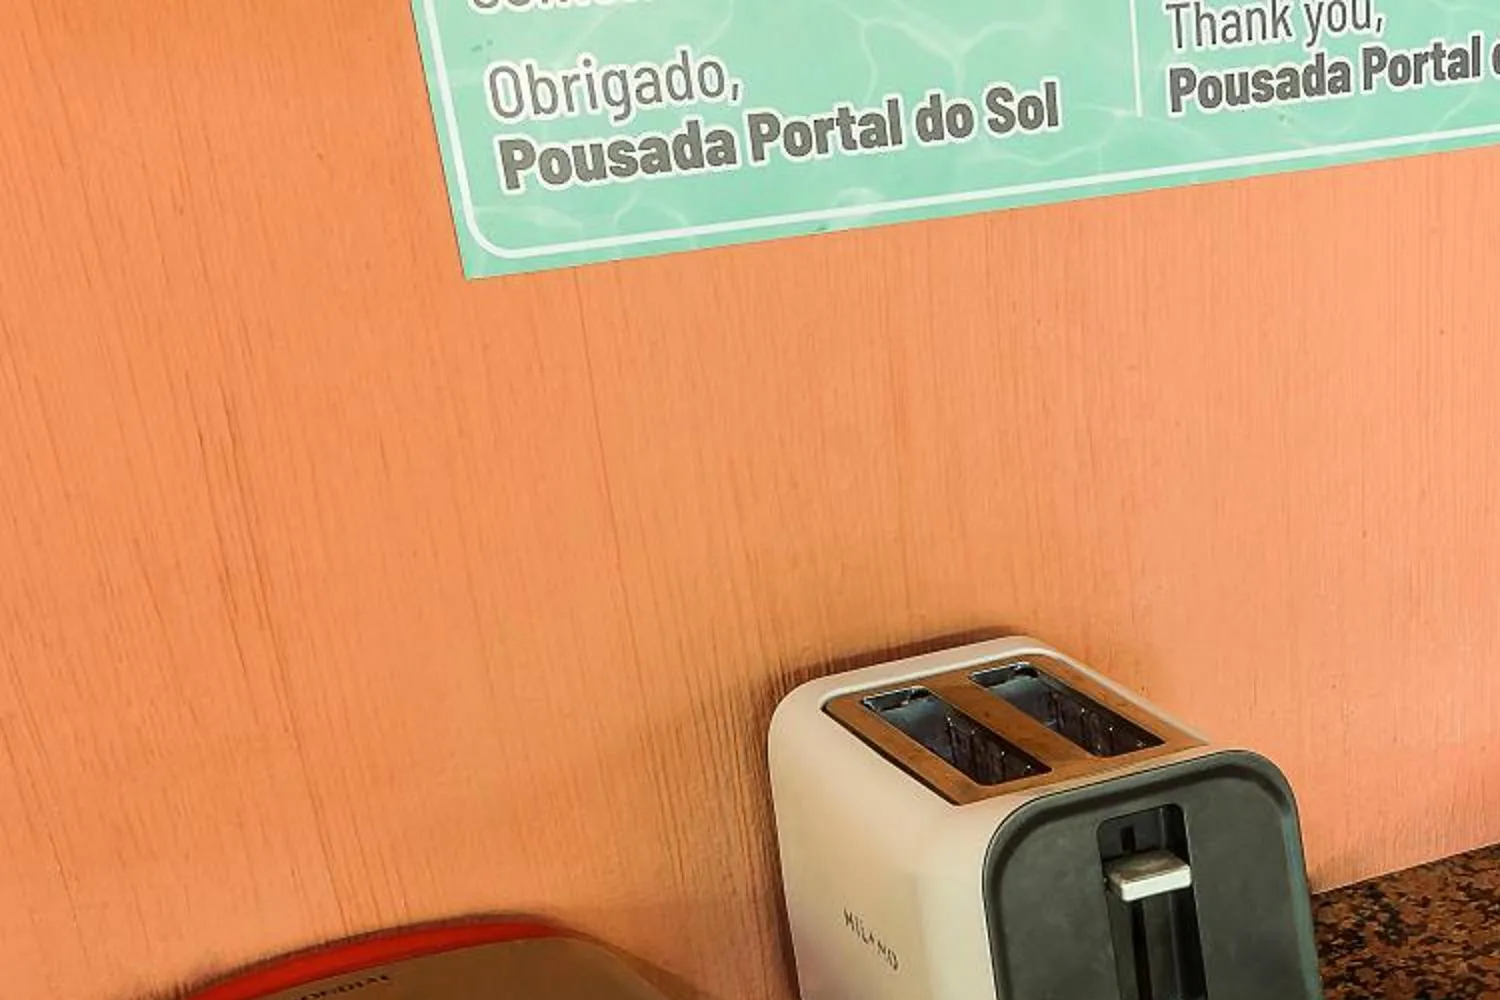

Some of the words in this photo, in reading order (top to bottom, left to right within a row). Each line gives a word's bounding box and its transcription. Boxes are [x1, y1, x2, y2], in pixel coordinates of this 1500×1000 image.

[1165, 1, 1292, 49] Thank
[1303, 0, 1383, 47] you,
[490, 50, 741, 121] Obrigado,
[1169, 53, 1351, 112] Pousada
[1362, 36, 1481, 91] Portal
[499, 121, 737, 190] Pousada
[748, 99, 902, 161] Portal
[916, 94, 974, 140] do
[985, 82, 1059, 133] Sol
